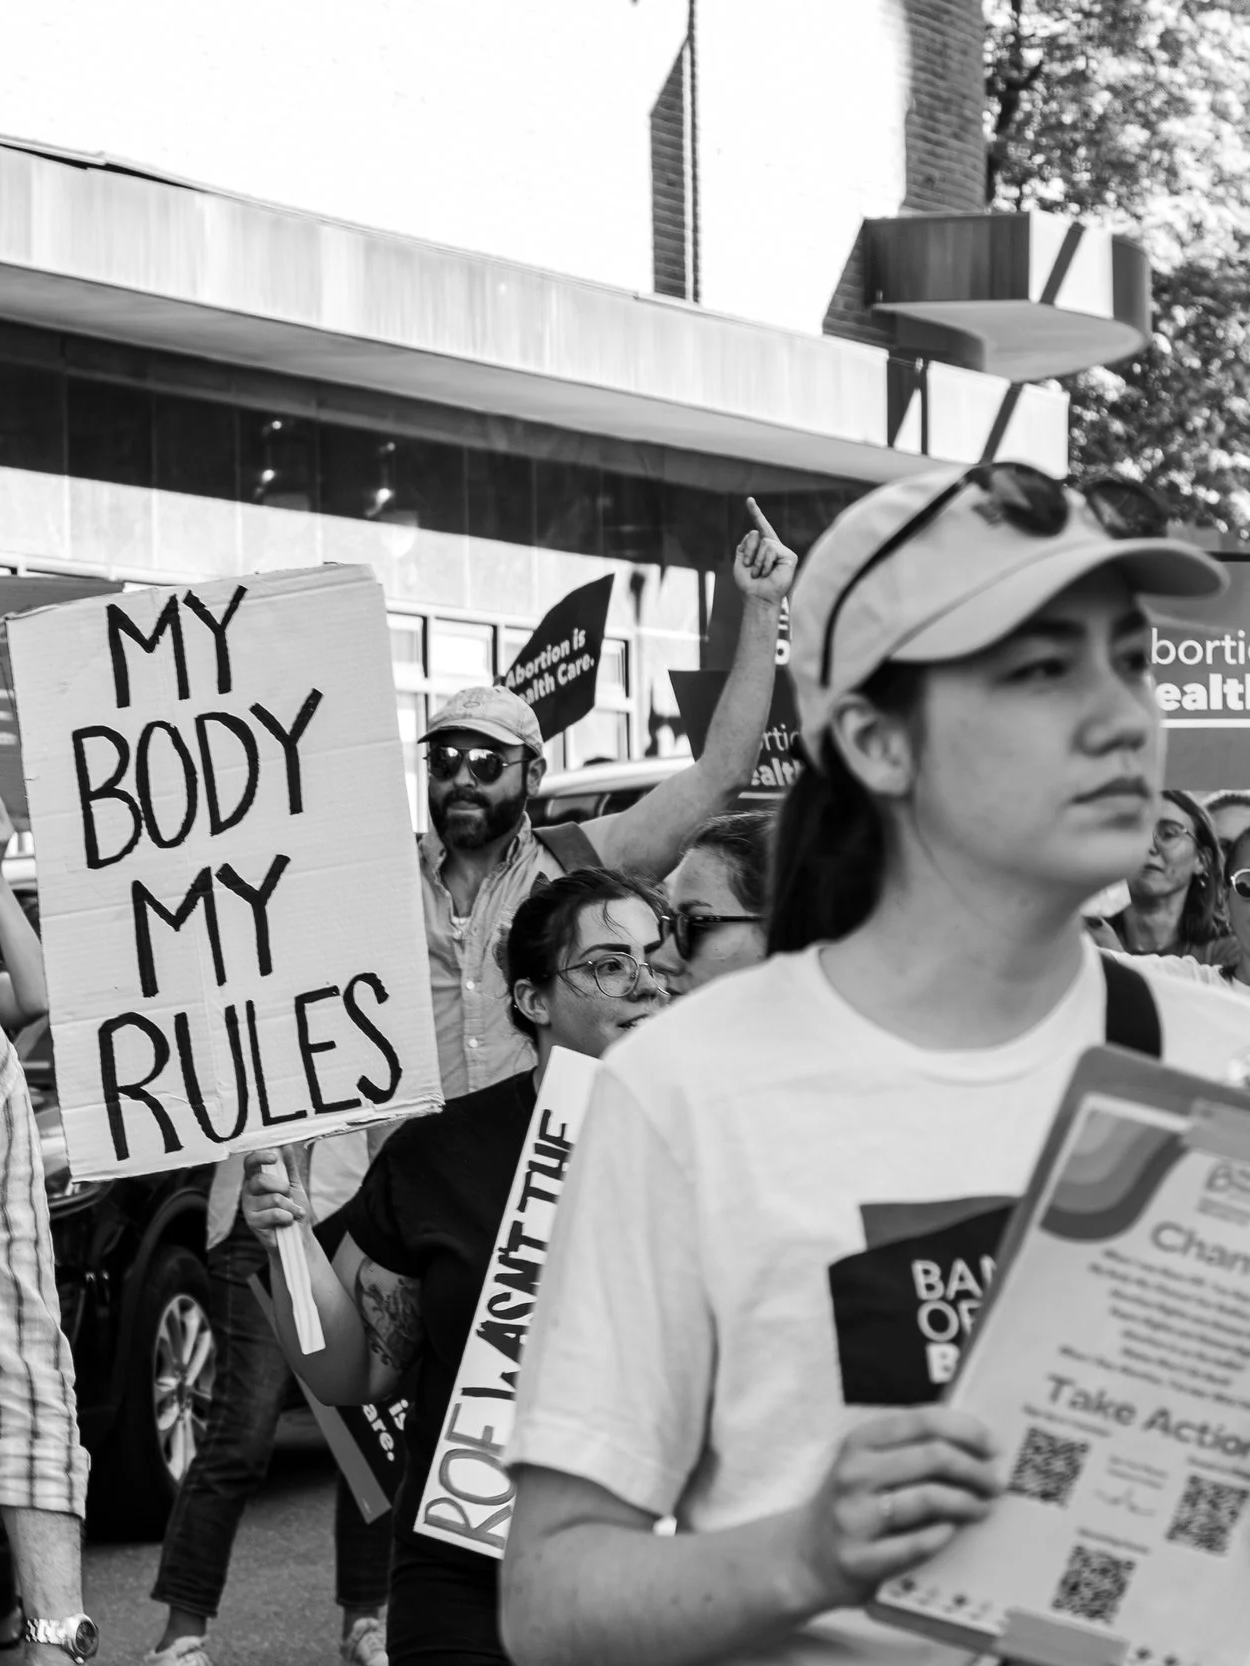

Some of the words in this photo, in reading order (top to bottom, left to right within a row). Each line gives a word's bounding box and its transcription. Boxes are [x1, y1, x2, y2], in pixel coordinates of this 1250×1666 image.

[106, 585, 249, 709] MY
[505, 639, 571, 689] Abortion
[572, 627, 586, 651] is
[1151, 627, 1250, 666] borti
[72, 688, 323, 869] BODY
[130, 855, 291, 998] MY
[98, 972, 403, 1161] RULES
[1047, 1371, 1137, 1427] Take
